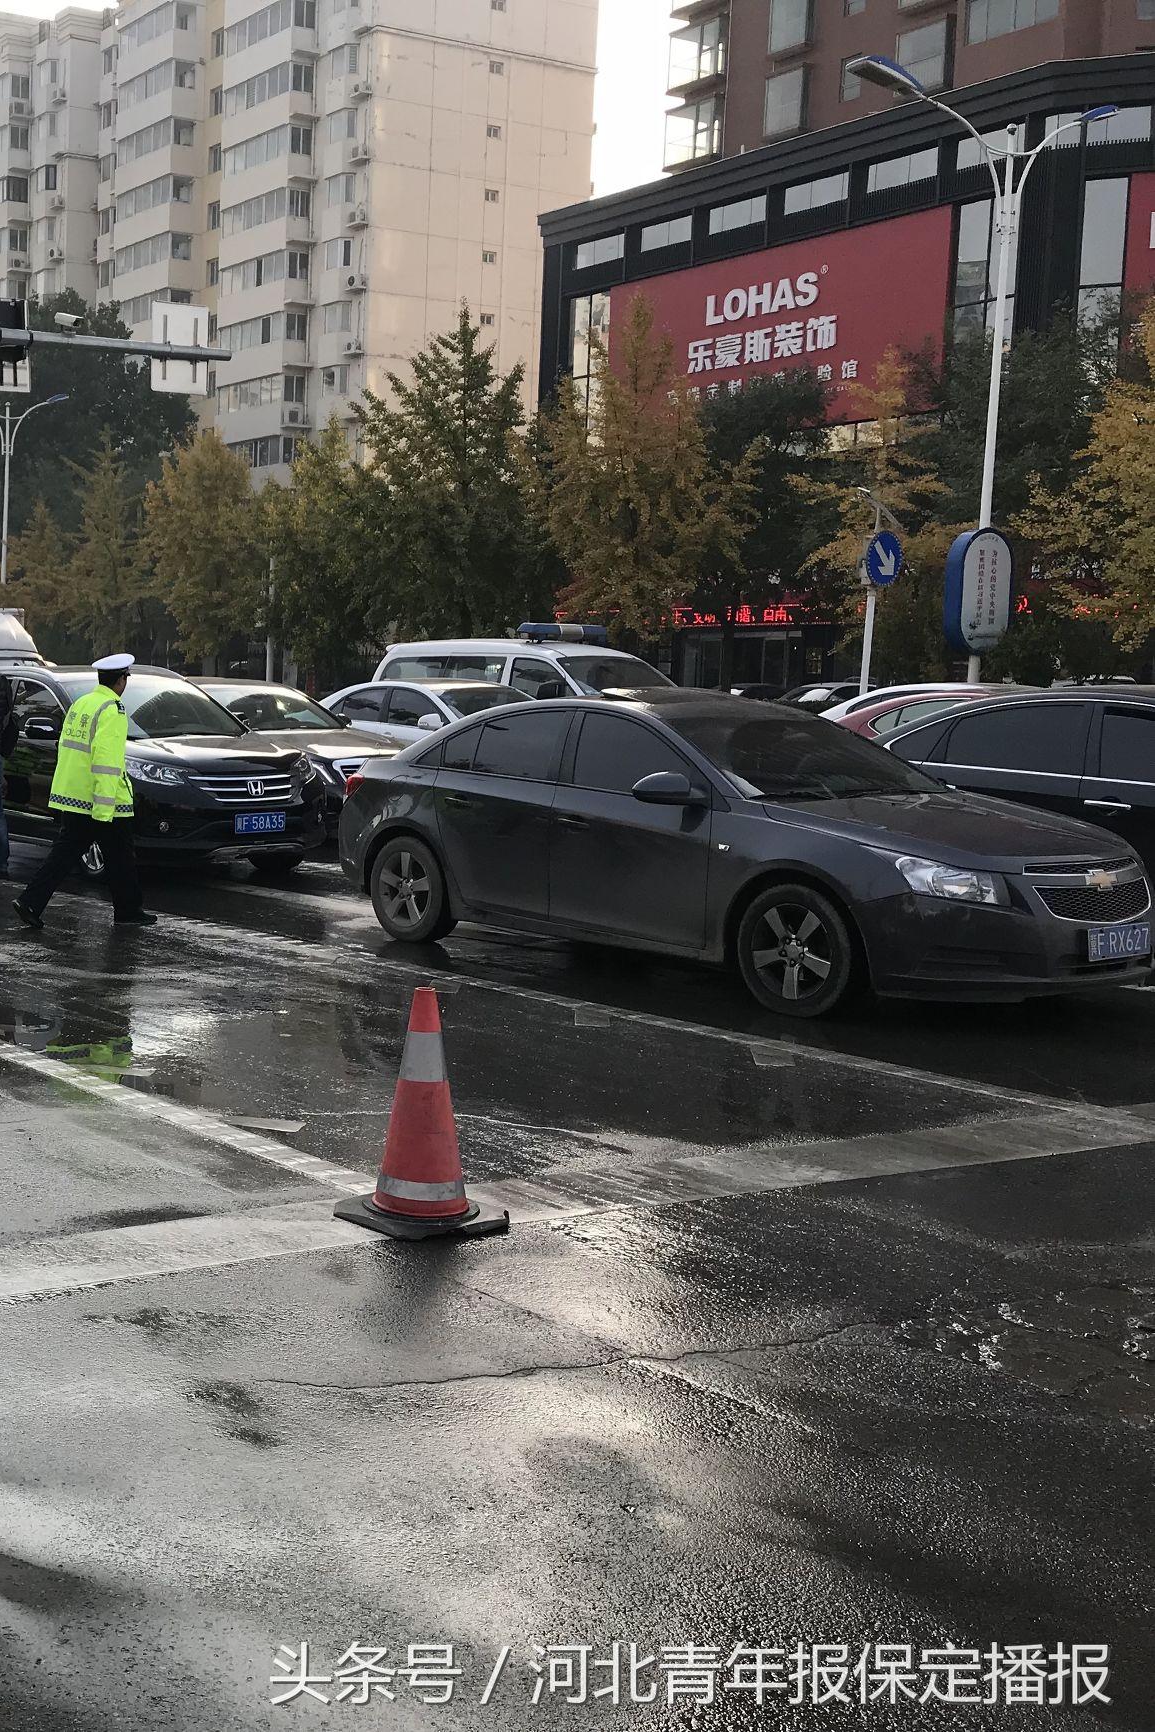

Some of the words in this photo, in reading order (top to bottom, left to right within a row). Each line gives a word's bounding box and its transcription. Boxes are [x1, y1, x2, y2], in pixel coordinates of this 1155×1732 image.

[705, 271, 820, 326] LOHAS
[687, 314, 838, 374] 乐豪斯装饰
